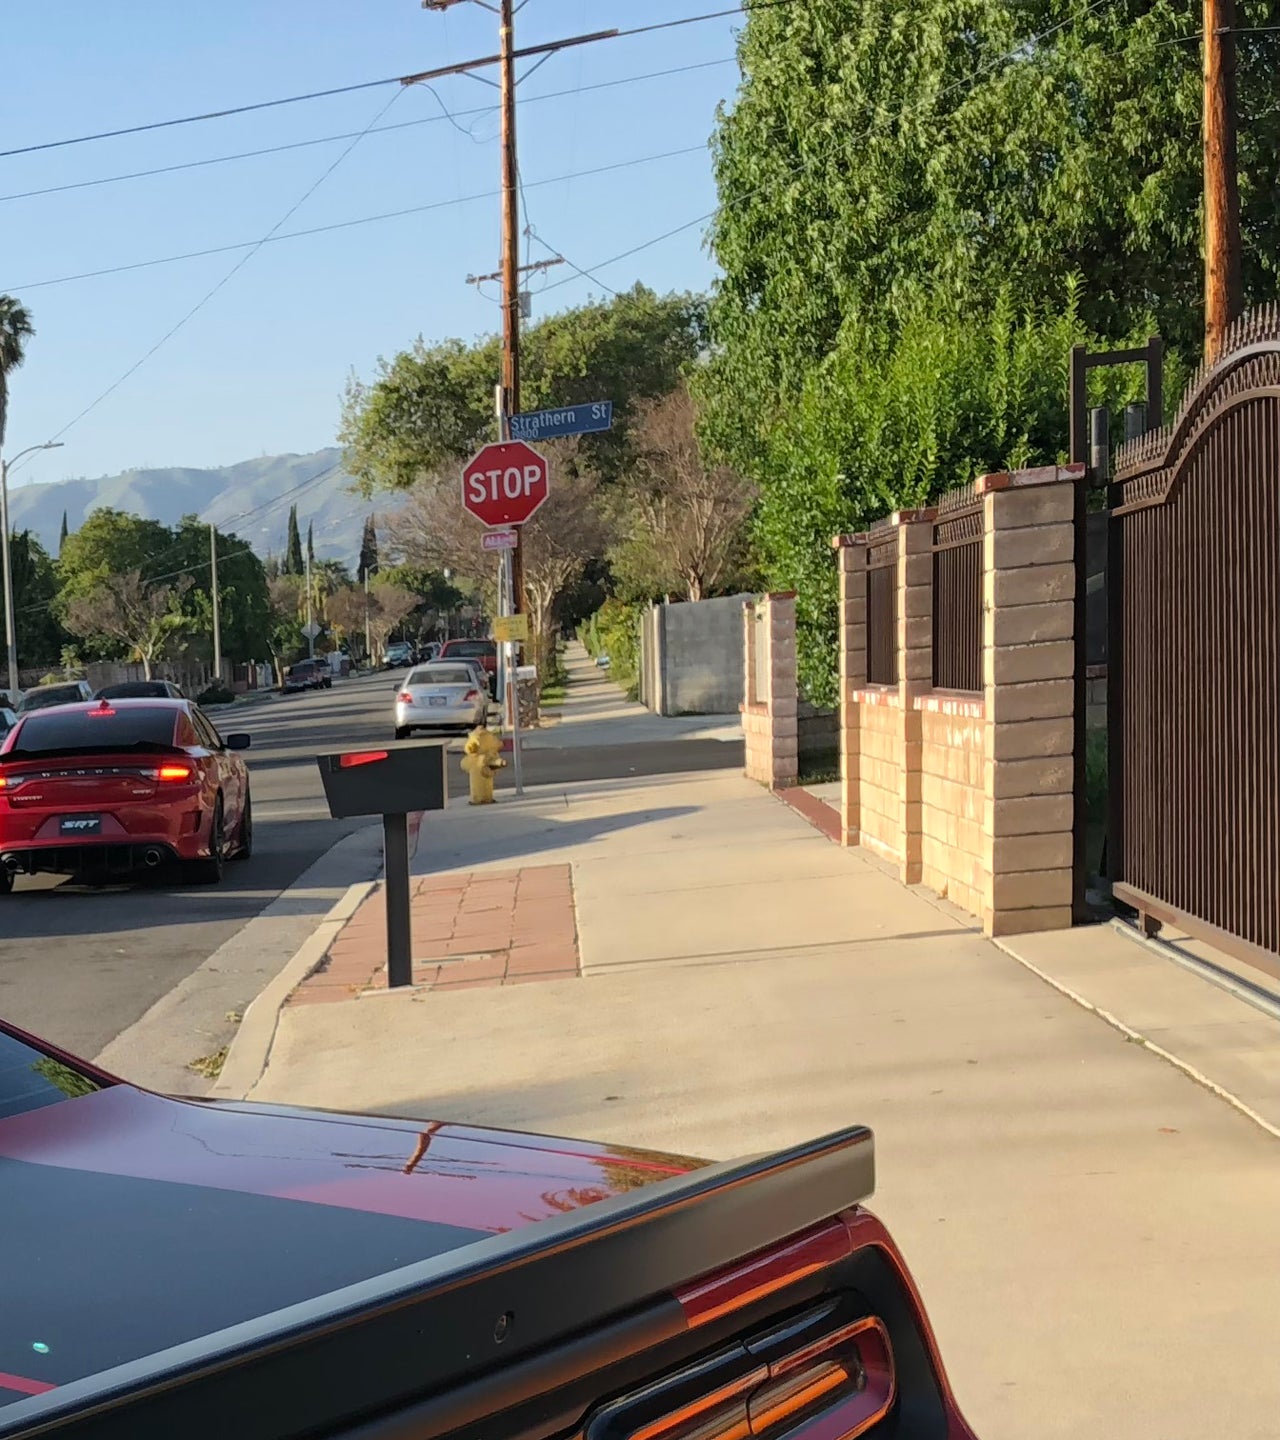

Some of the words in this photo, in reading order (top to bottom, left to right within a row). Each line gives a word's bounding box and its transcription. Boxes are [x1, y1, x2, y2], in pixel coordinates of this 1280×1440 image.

[511, 411, 576, 431] Strathern
[591, 404, 607, 420] St
[468, 465, 542, 504] STOP
[61, 819, 100, 830] SRT
